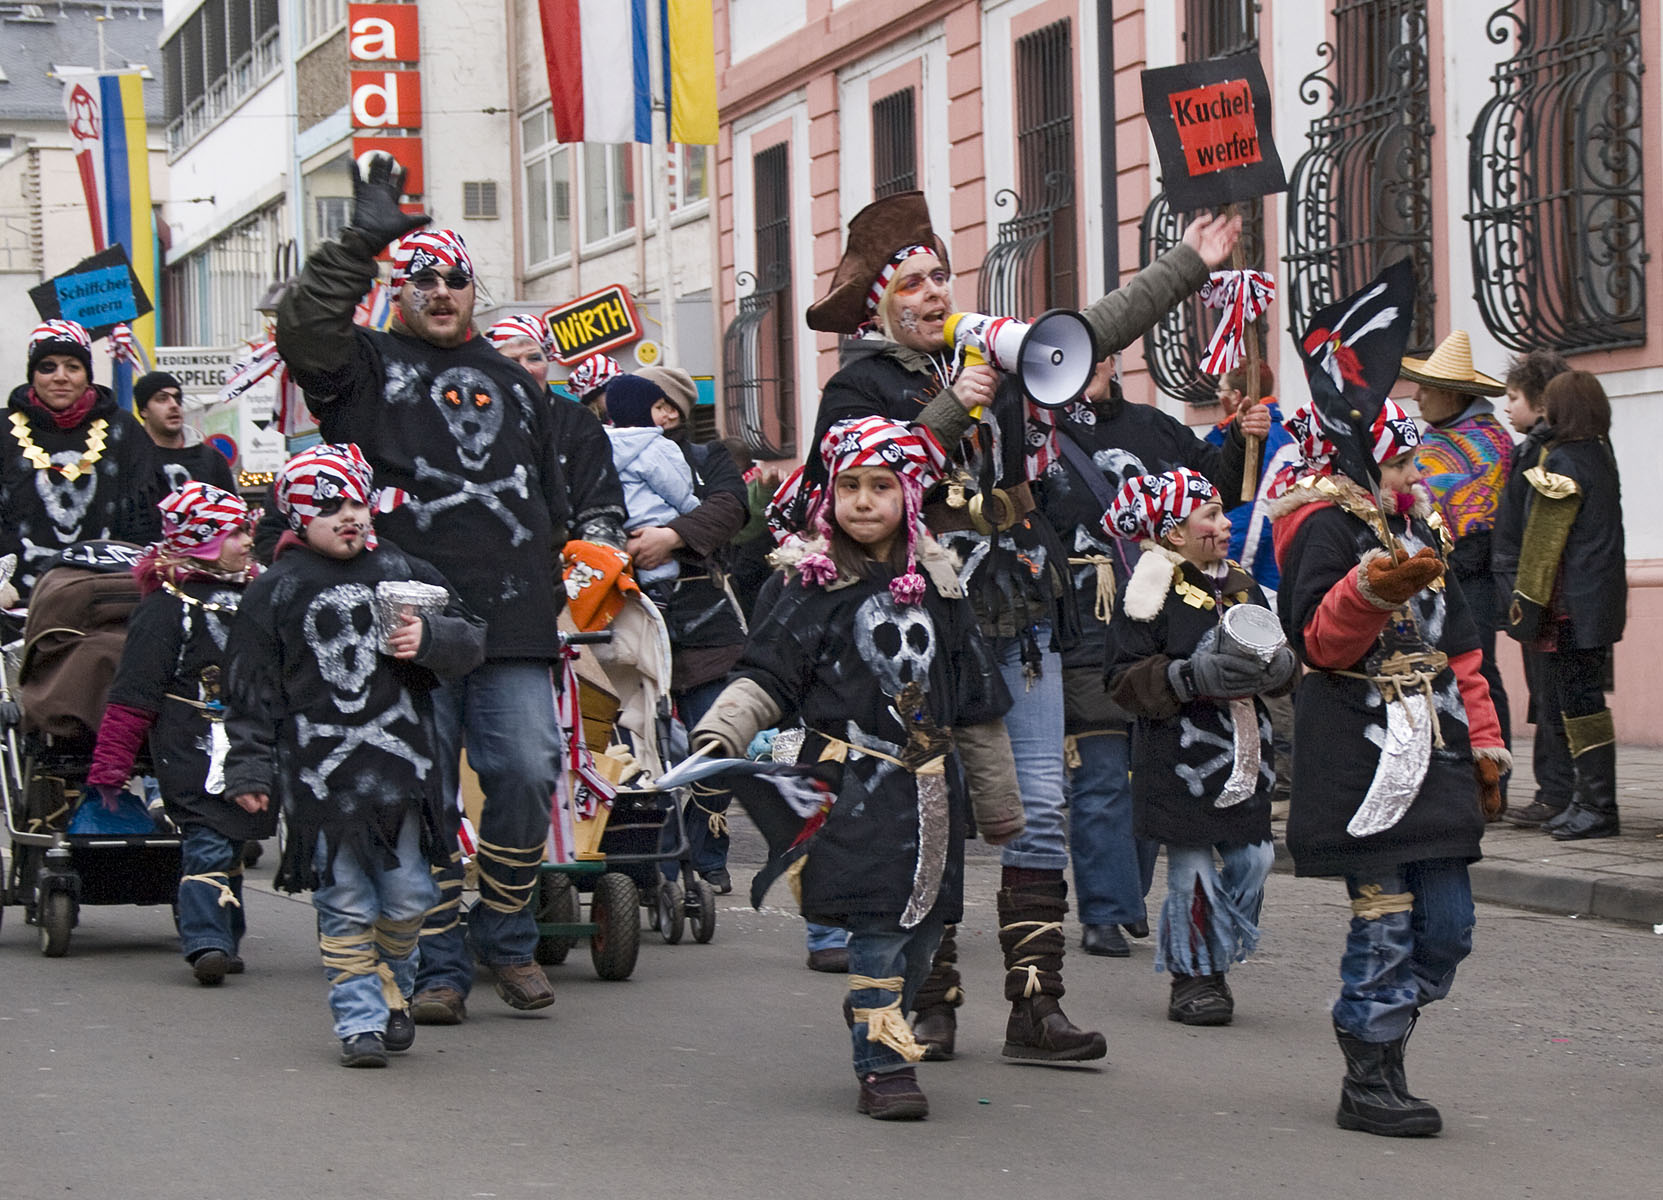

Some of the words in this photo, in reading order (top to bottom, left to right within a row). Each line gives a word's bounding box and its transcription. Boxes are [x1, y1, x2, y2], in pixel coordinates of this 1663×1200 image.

[1175, 87, 1250, 127] Kuchel
[1196, 131, 1257, 167] werfer
[78, 300, 123, 317] entern
[168, 370, 227, 386] SPFLEG
